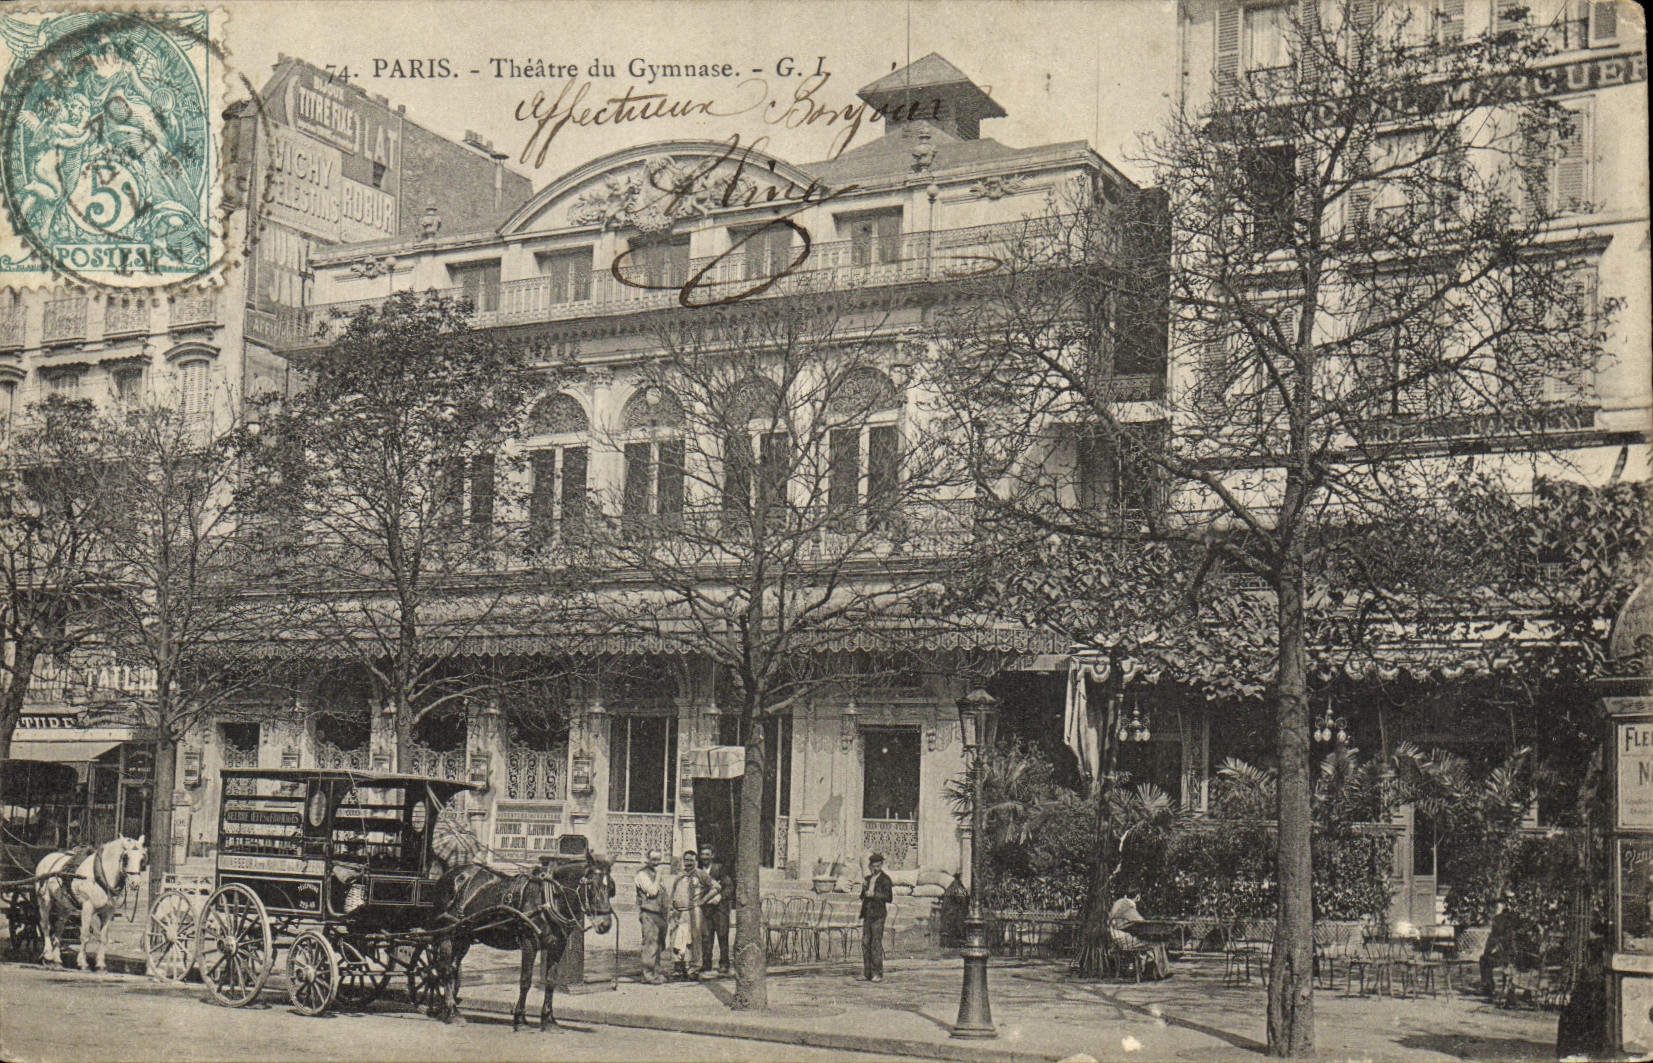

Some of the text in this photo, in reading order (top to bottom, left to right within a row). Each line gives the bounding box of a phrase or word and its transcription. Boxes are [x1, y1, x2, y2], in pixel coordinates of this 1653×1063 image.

[273, 136, 335, 190] VICHY
[342, 181, 395, 236] ROBUR
[56, 247, 149, 269] POSTES
